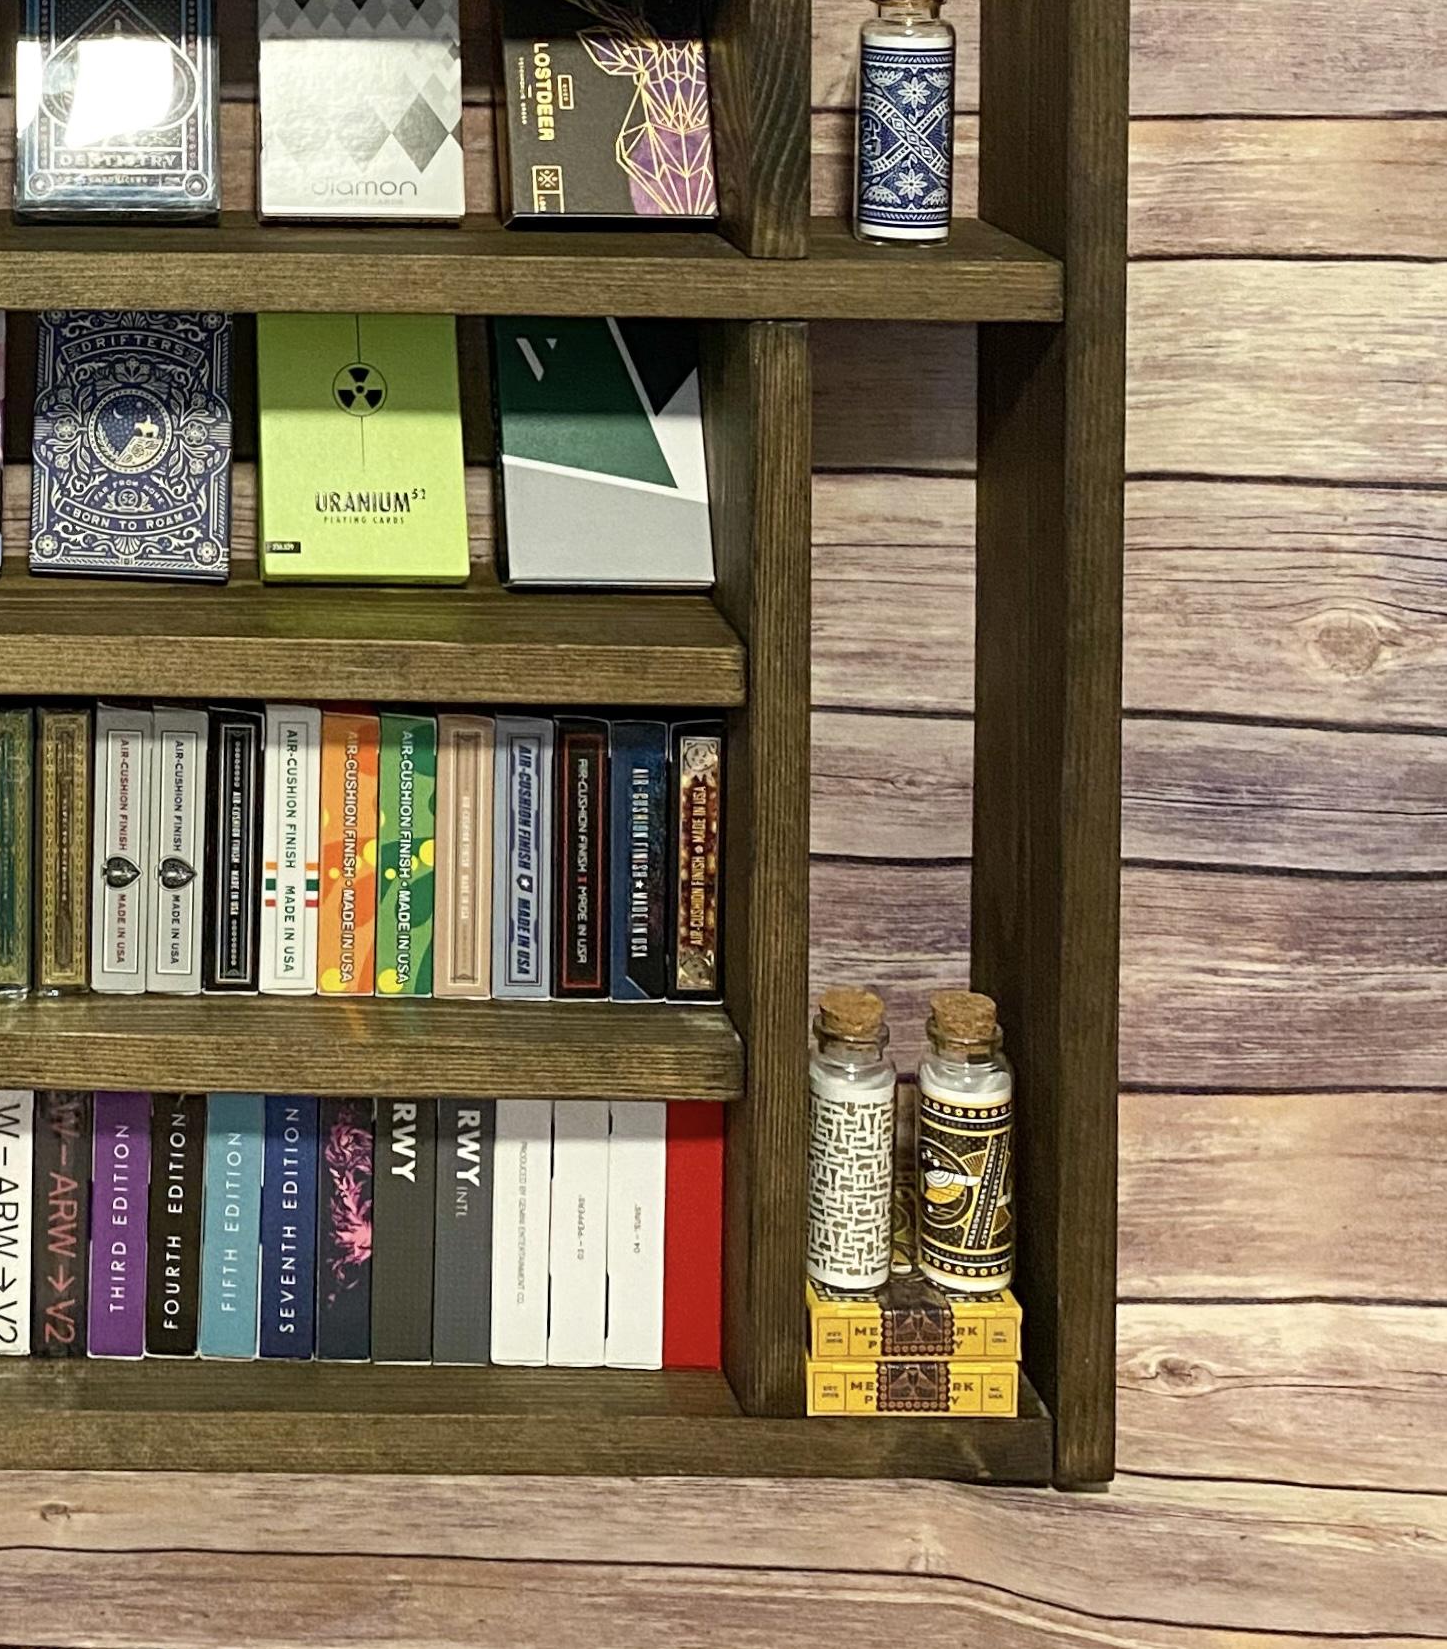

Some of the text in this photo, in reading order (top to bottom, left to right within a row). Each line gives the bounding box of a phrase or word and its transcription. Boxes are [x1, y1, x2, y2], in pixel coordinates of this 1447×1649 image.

[533, 43, 554, 141] LOSTDEER
[81, 334, 186, 357] DRIFTERS
[73, 508, 186, 530] BORN TO ROAM
[324, 516, 405, 524] PLAYING CARDS
[170, 740, 183, 964] AIR-CUSHION FINISH MADE IN USA
[283, 729, 297, 972] AIR-CUSHION FINISH MADE IN USA
[396, 731, 413, 983] AIR-CUSHION FINISH MADE IN USA
[517, 746, 532, 974] AIR-CUSHION FINISH MADE IN USA
[577, 759, 588, 963] AIR-CUSHION FINISH MADE IN USA
[109, 1125, 129, 1312] THIRD EDITION
[163, 1114, 185, 1329] FOURTH EDITION
[221, 1133, 241, 1312] FIFTH EDITION
[280, 1109, 298, 1333] SEVENTH EDITION
[391, 1102, 416, 1182] RWY
[455, 1110, 481, 1218] RWY INTL
